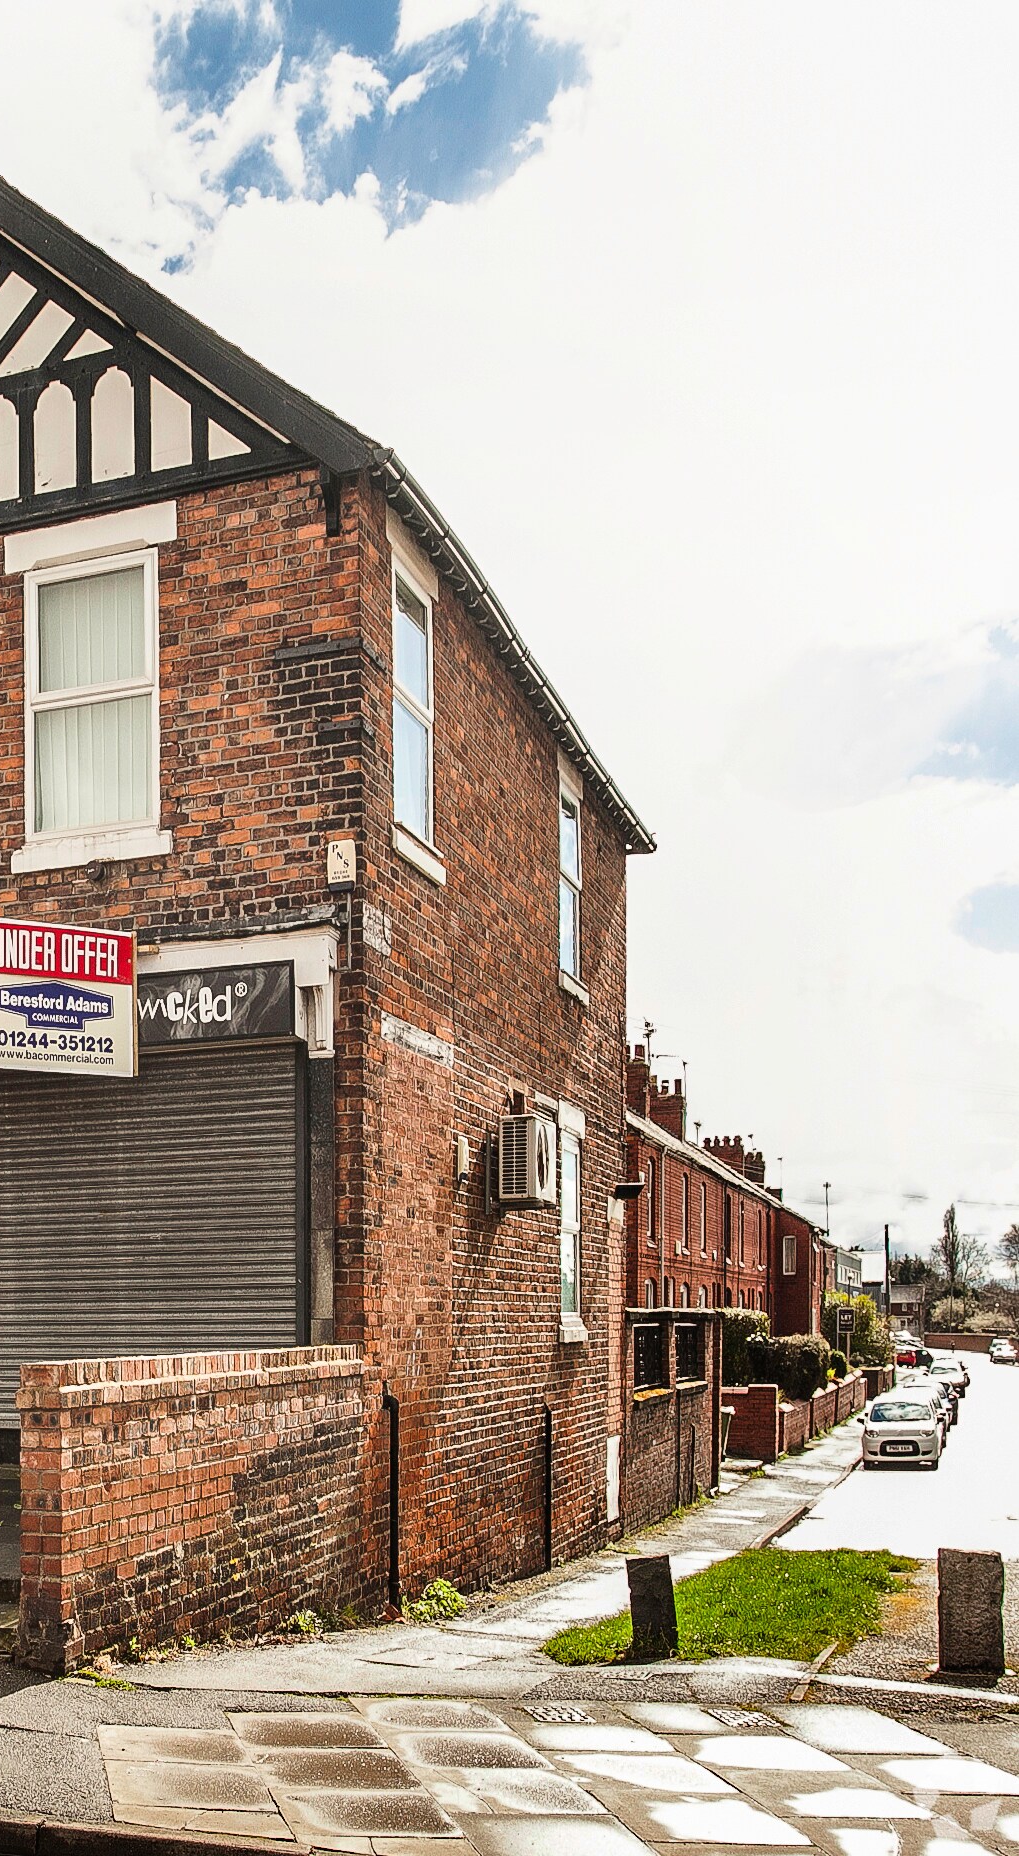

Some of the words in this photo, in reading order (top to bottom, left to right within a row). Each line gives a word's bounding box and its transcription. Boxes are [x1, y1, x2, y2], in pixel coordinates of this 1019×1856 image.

[60, 933, 119, 978] OFFER
[0, 990, 64, 1010] Beresford
[66, 995, 109, 1014] Adams
[31, 1012, 79, 1024] COMMERCIAL
